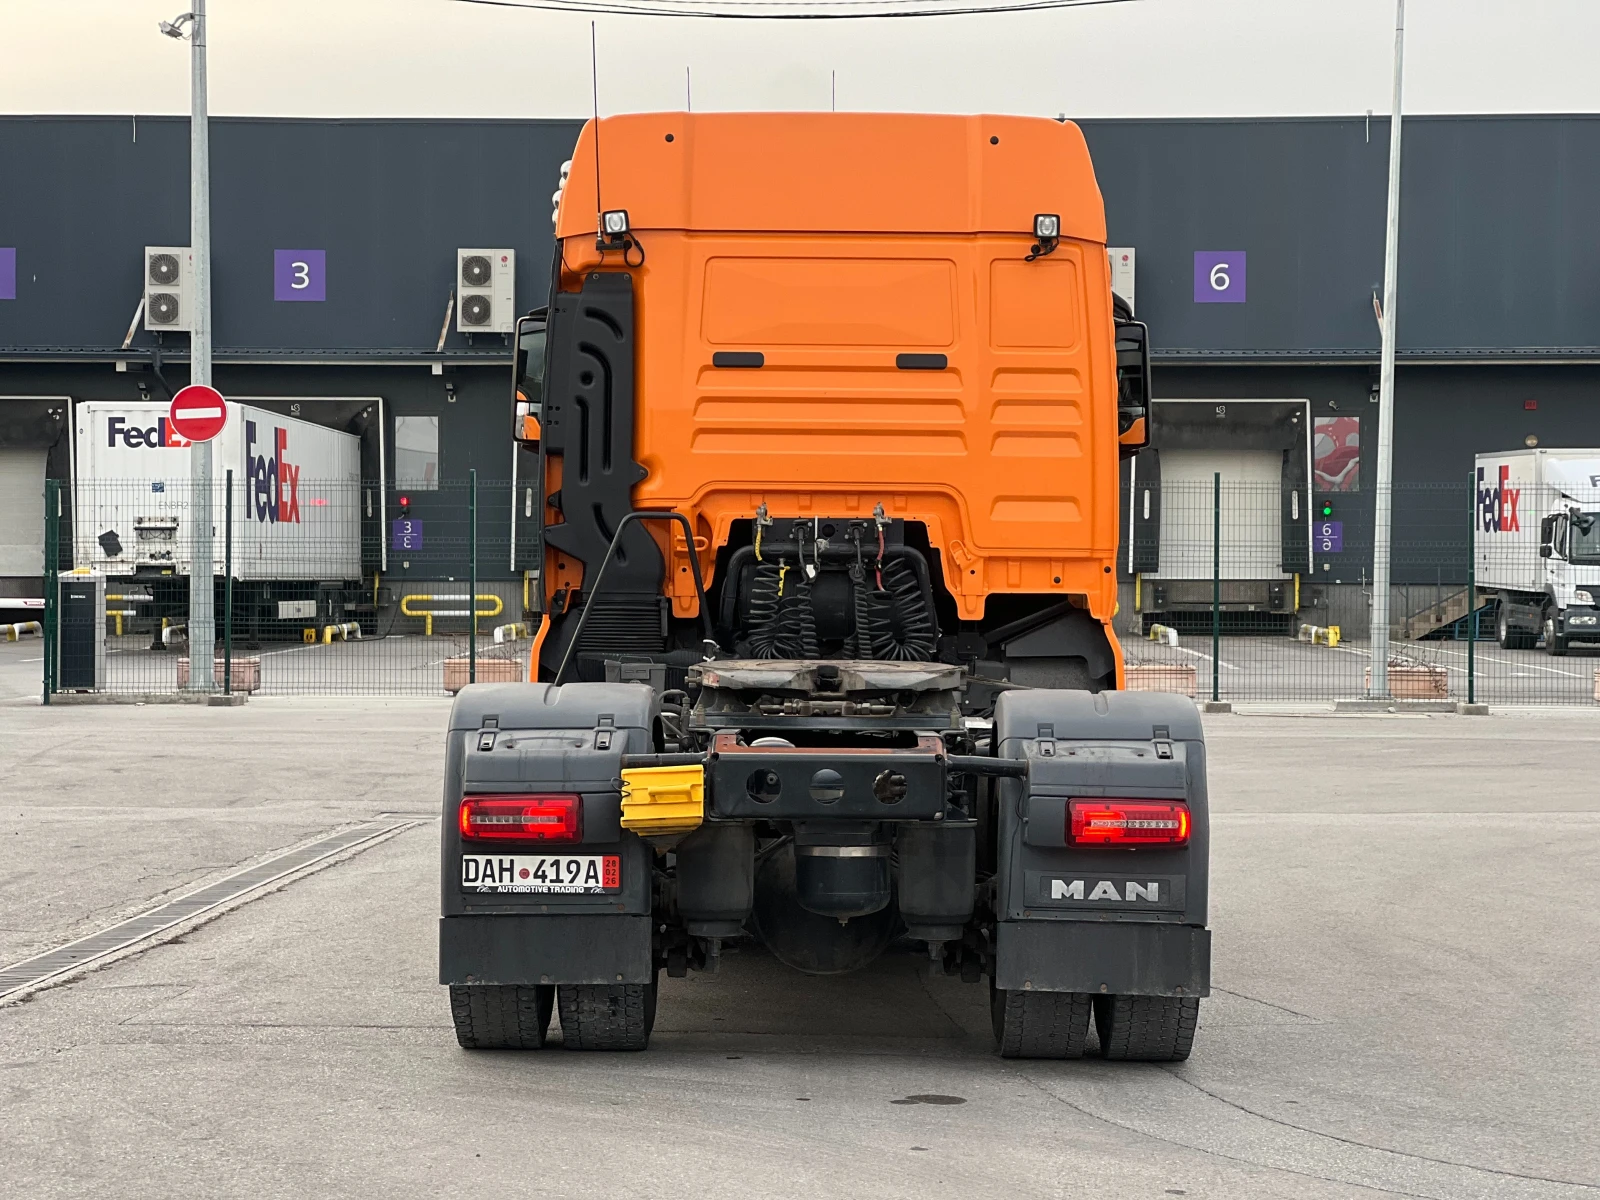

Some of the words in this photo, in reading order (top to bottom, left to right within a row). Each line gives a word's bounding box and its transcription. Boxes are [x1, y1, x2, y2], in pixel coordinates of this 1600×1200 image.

[291, 261, 310, 289] 3
[1210, 263, 1230, 291] 6
[107, 416, 192, 448] FedE
[245, 419, 301, 524] FedEx
[1476, 465, 1521, 533] FedEx
[403, 521, 412, 534] 3
[1322, 523, 1332, 536] 6
[463, 858, 514, 884] DAH
[533, 859, 600, 885] 419A
[605, 859, 617, 868] 28
[605, 868, 617, 877] 02
[497, 886, 549, 894] AUTOMOTIVE
[550, 886, 585, 894] TRADING
[605, 877, 617, 885] 26
[1051, 879, 1159, 902] MAN
